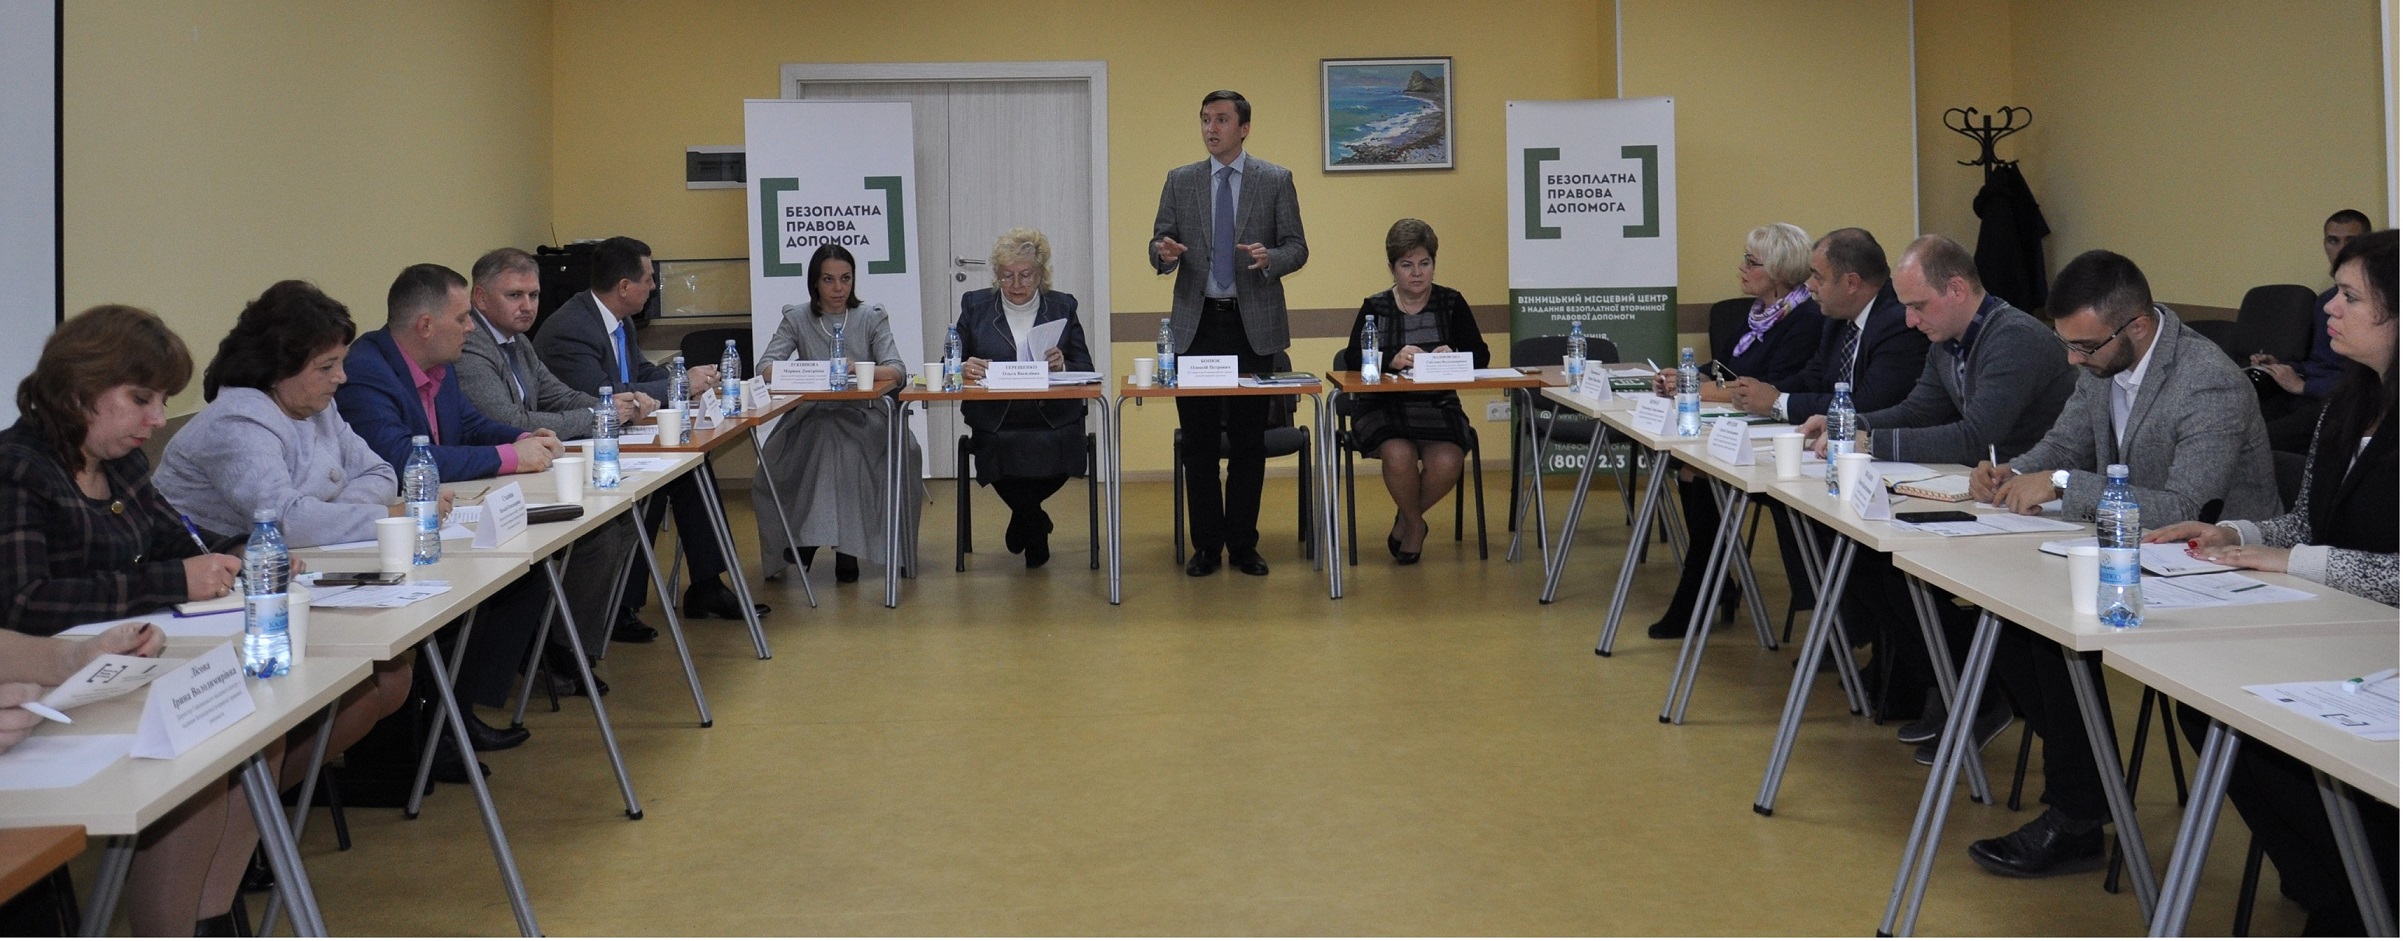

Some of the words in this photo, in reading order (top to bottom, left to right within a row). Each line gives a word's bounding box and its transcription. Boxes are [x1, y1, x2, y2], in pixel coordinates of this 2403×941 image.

[1547, 173, 1637, 185] БЕЗОПЛАТНА
[1547, 188, 1613, 199] ПРАВОВА
[785, 205, 882, 217] БЕЗОПЛАТНА
[1547, 202, 1626, 214] ДОПОМОГА
[786, 220, 856, 232] ПРАВОВА
[786, 234, 870, 248] ДОПОМОГА
[1518, 293, 1582, 305] ВІННИЦЬКИЙ
[1584, 293, 1635, 304] МІСЦЕВИЙ
[1637, 294, 1669, 304] ЦЕНТР
[1566, 304, 1620, 313] БЕЗОПЛАТНОЇ
[1620, 303, 1666, 312] ВТОРИННОЇ
[1551, 313, 1591, 321] ПРАВОВОЇ
[1592, 313, 1636, 321] ДОПОМОГИ
[1549, 454, 1587, 472] (800
[1598, 454, 1626, 469] 23
[172, 692, 192, 710] Ірина
[190, 668, 237, 698] Володимирівна
